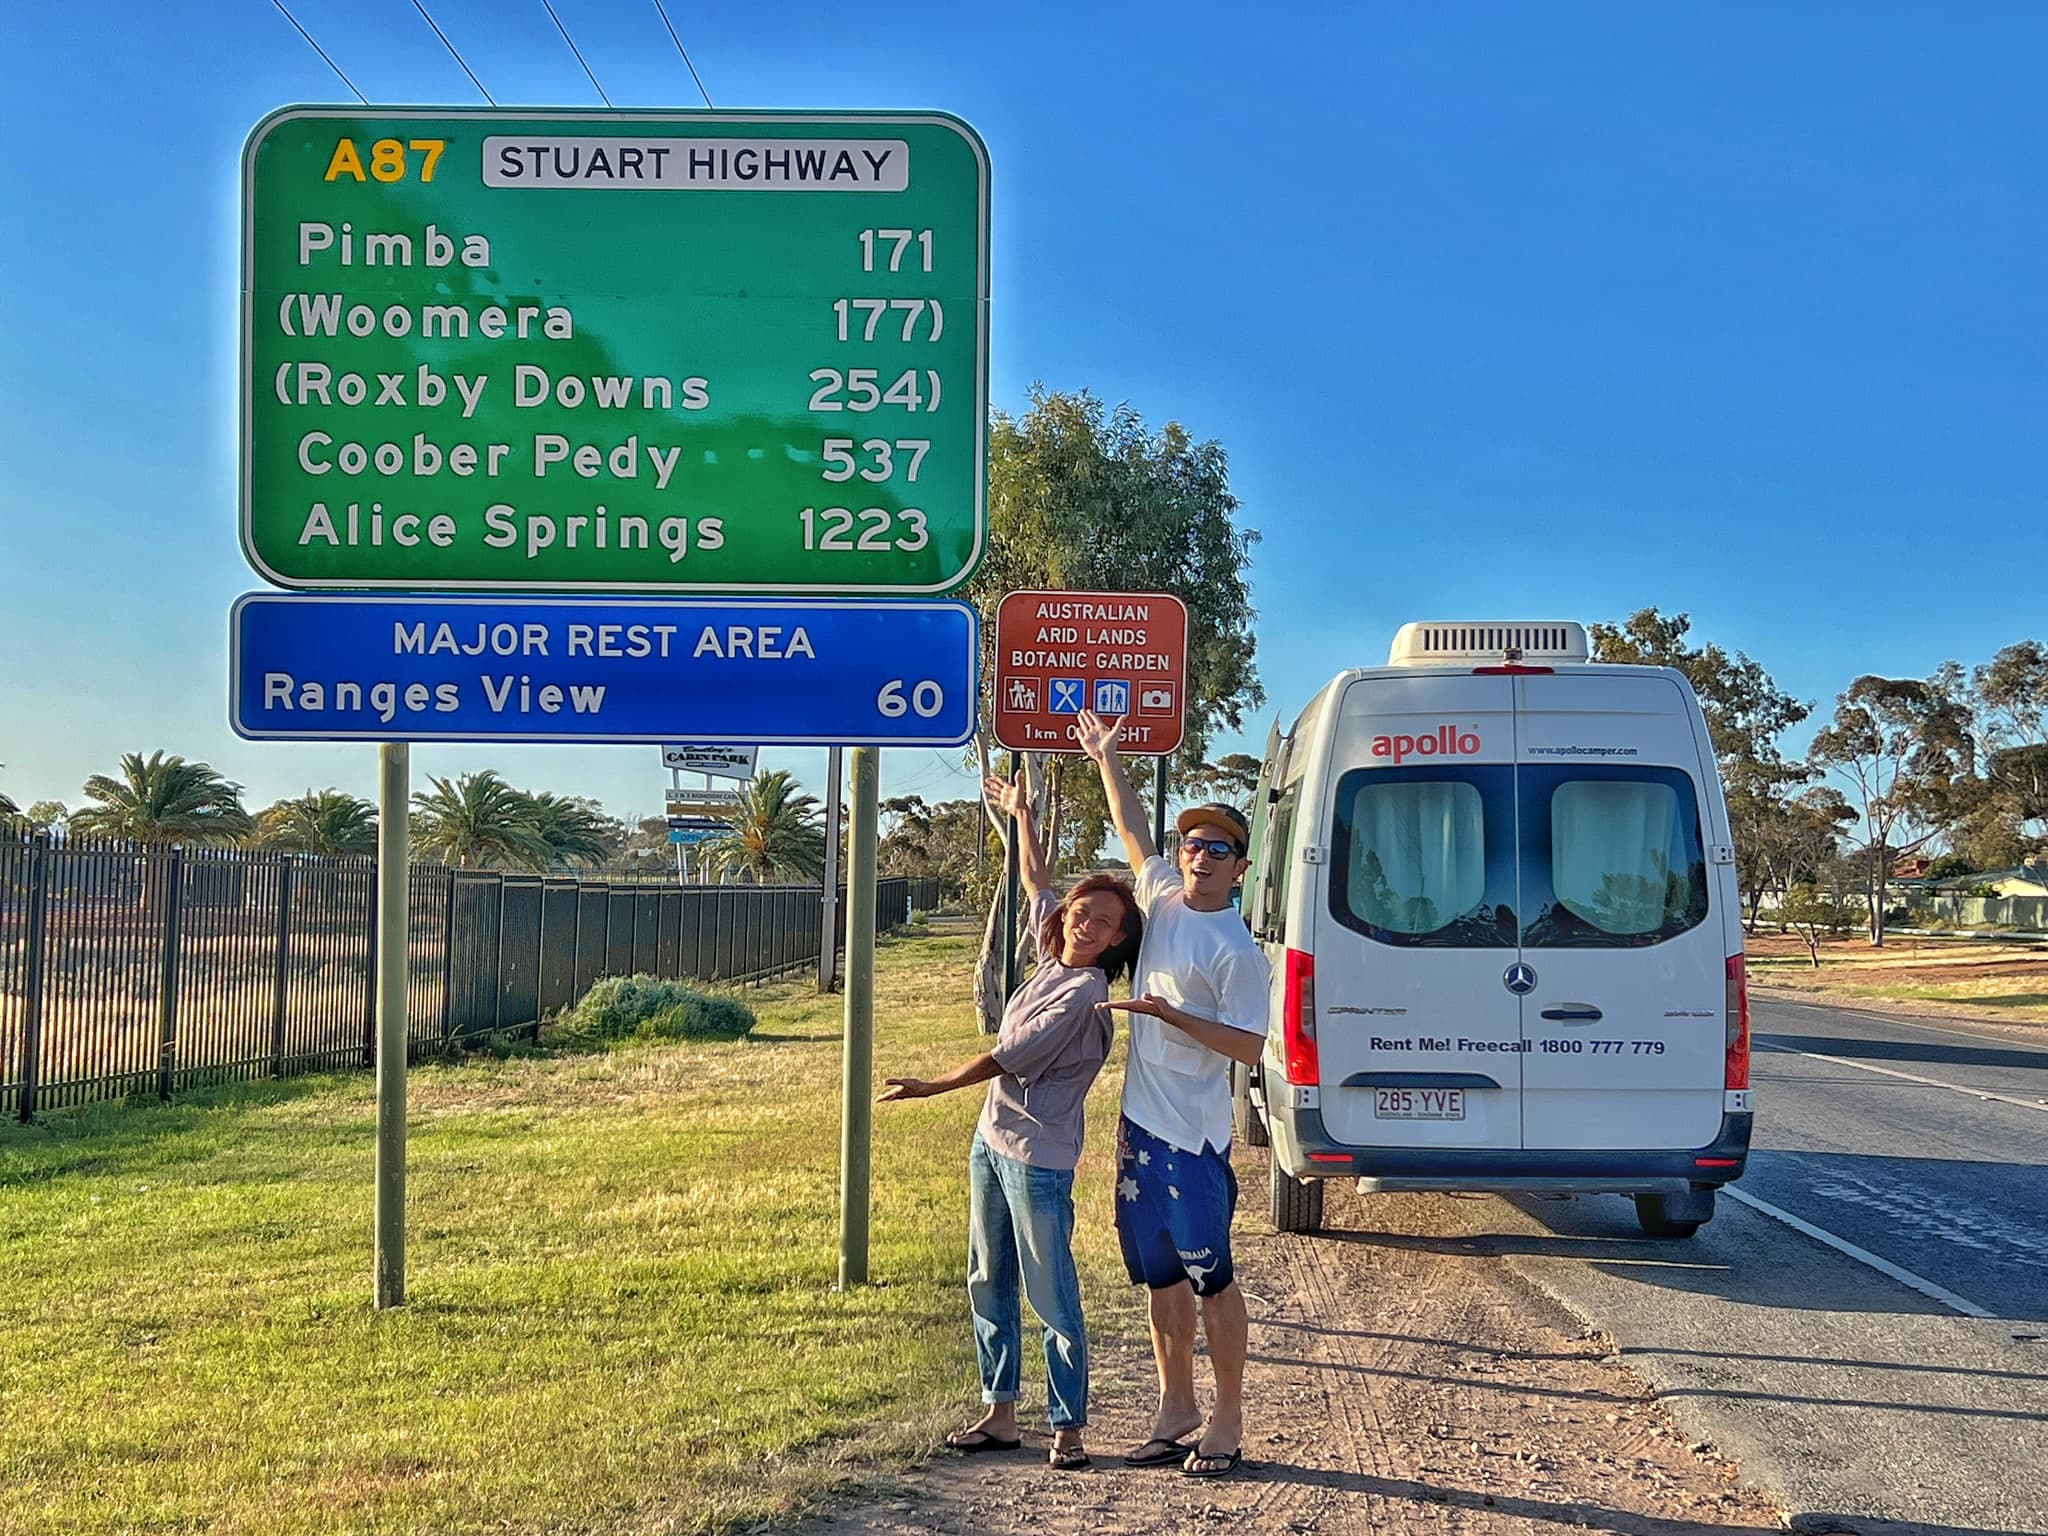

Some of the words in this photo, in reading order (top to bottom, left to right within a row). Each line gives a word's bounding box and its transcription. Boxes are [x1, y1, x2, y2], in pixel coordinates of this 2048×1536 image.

[323, 139, 445, 184] A87
[499, 146, 670, 181] STUART
[687, 147, 894, 183] HIGHWAY
[299, 222, 492, 269] Pimba
[858, 229, 935, 273] 171
[279, 293, 575, 340] (Woomera
[832, 298, 944, 344] 177)
[275, 361, 489, 418] (Roxby
[514, 364, 711, 410] Downs
[807, 368, 942, 414] 254)
[298, 431, 510, 477] Coober
[534, 434, 682, 489] Pedy
[820, 438, 931, 483] 537
[298, 502, 458, 547] Alice
[483, 504, 726, 563] Springs
[799, 507, 929, 552] 1223
[1036, 602, 1149, 621] AUSTRALIAN
[394, 621, 549, 658] MAJOR
[567, 624, 678, 659] REST
[692, 626, 816, 660] AREA
[1036, 627, 1078, 644] ARID
[1086, 628, 1147, 646] LANDS
[1011, 650, 1088, 669] BOTANIC
[1096, 653, 1170, 671] GARDEN
[263, 672, 461, 724] Ranges
[481, 675, 606, 714] View
[876, 679, 944, 718] 60
[1117, 726, 1151, 743] GHT
[1371, 725, 1481, 764] apollo
[1528, 745, 1638, 757] www.apollocamper.com
[666, 752, 710, 762] CABIN
[711, 754, 749, 765] PARK
[1370, 1037, 1412, 1052] Rent
[1418, 1037, 1452, 1052] Me!
[1457, 1038, 1532, 1054] Freecall
[1539, 1039, 1583, 1054] 1800
[1589, 1040, 1624, 1055] 777
[1631, 1041, 1665, 1056] 779
